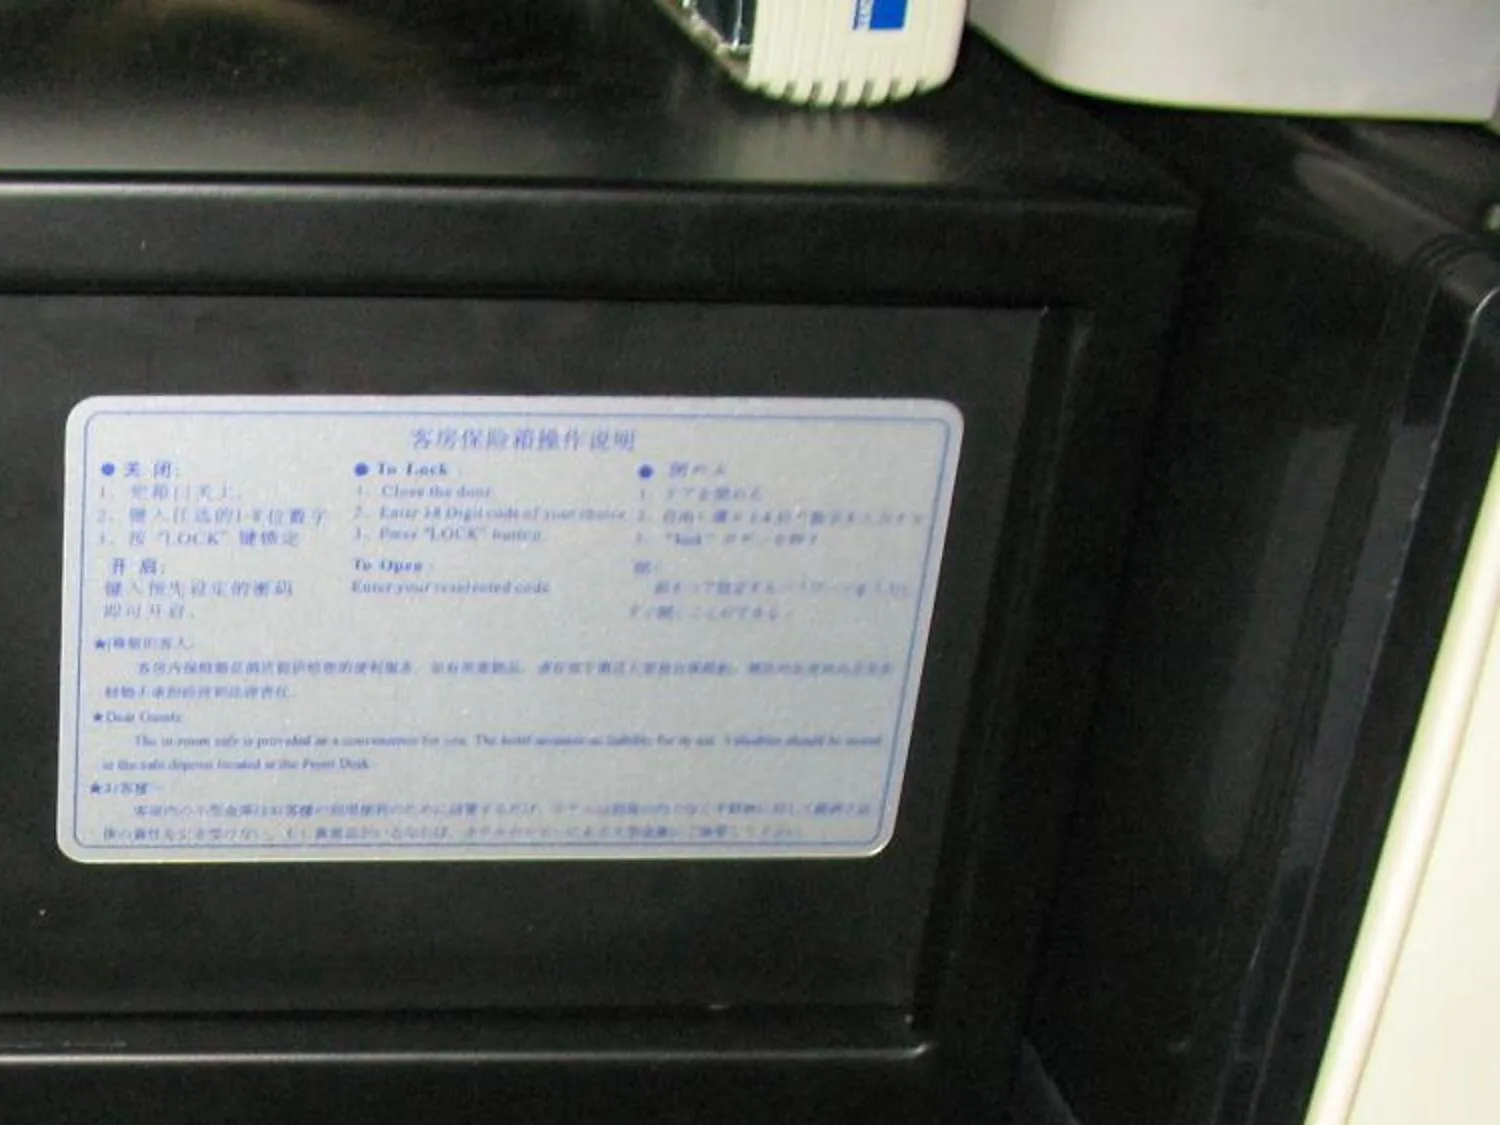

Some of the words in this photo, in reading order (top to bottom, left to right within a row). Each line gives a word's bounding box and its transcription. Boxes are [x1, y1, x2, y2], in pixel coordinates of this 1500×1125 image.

[377, 462, 397, 476] To
[353, 559, 372, 573] To
[380, 559, 424, 575] Open
